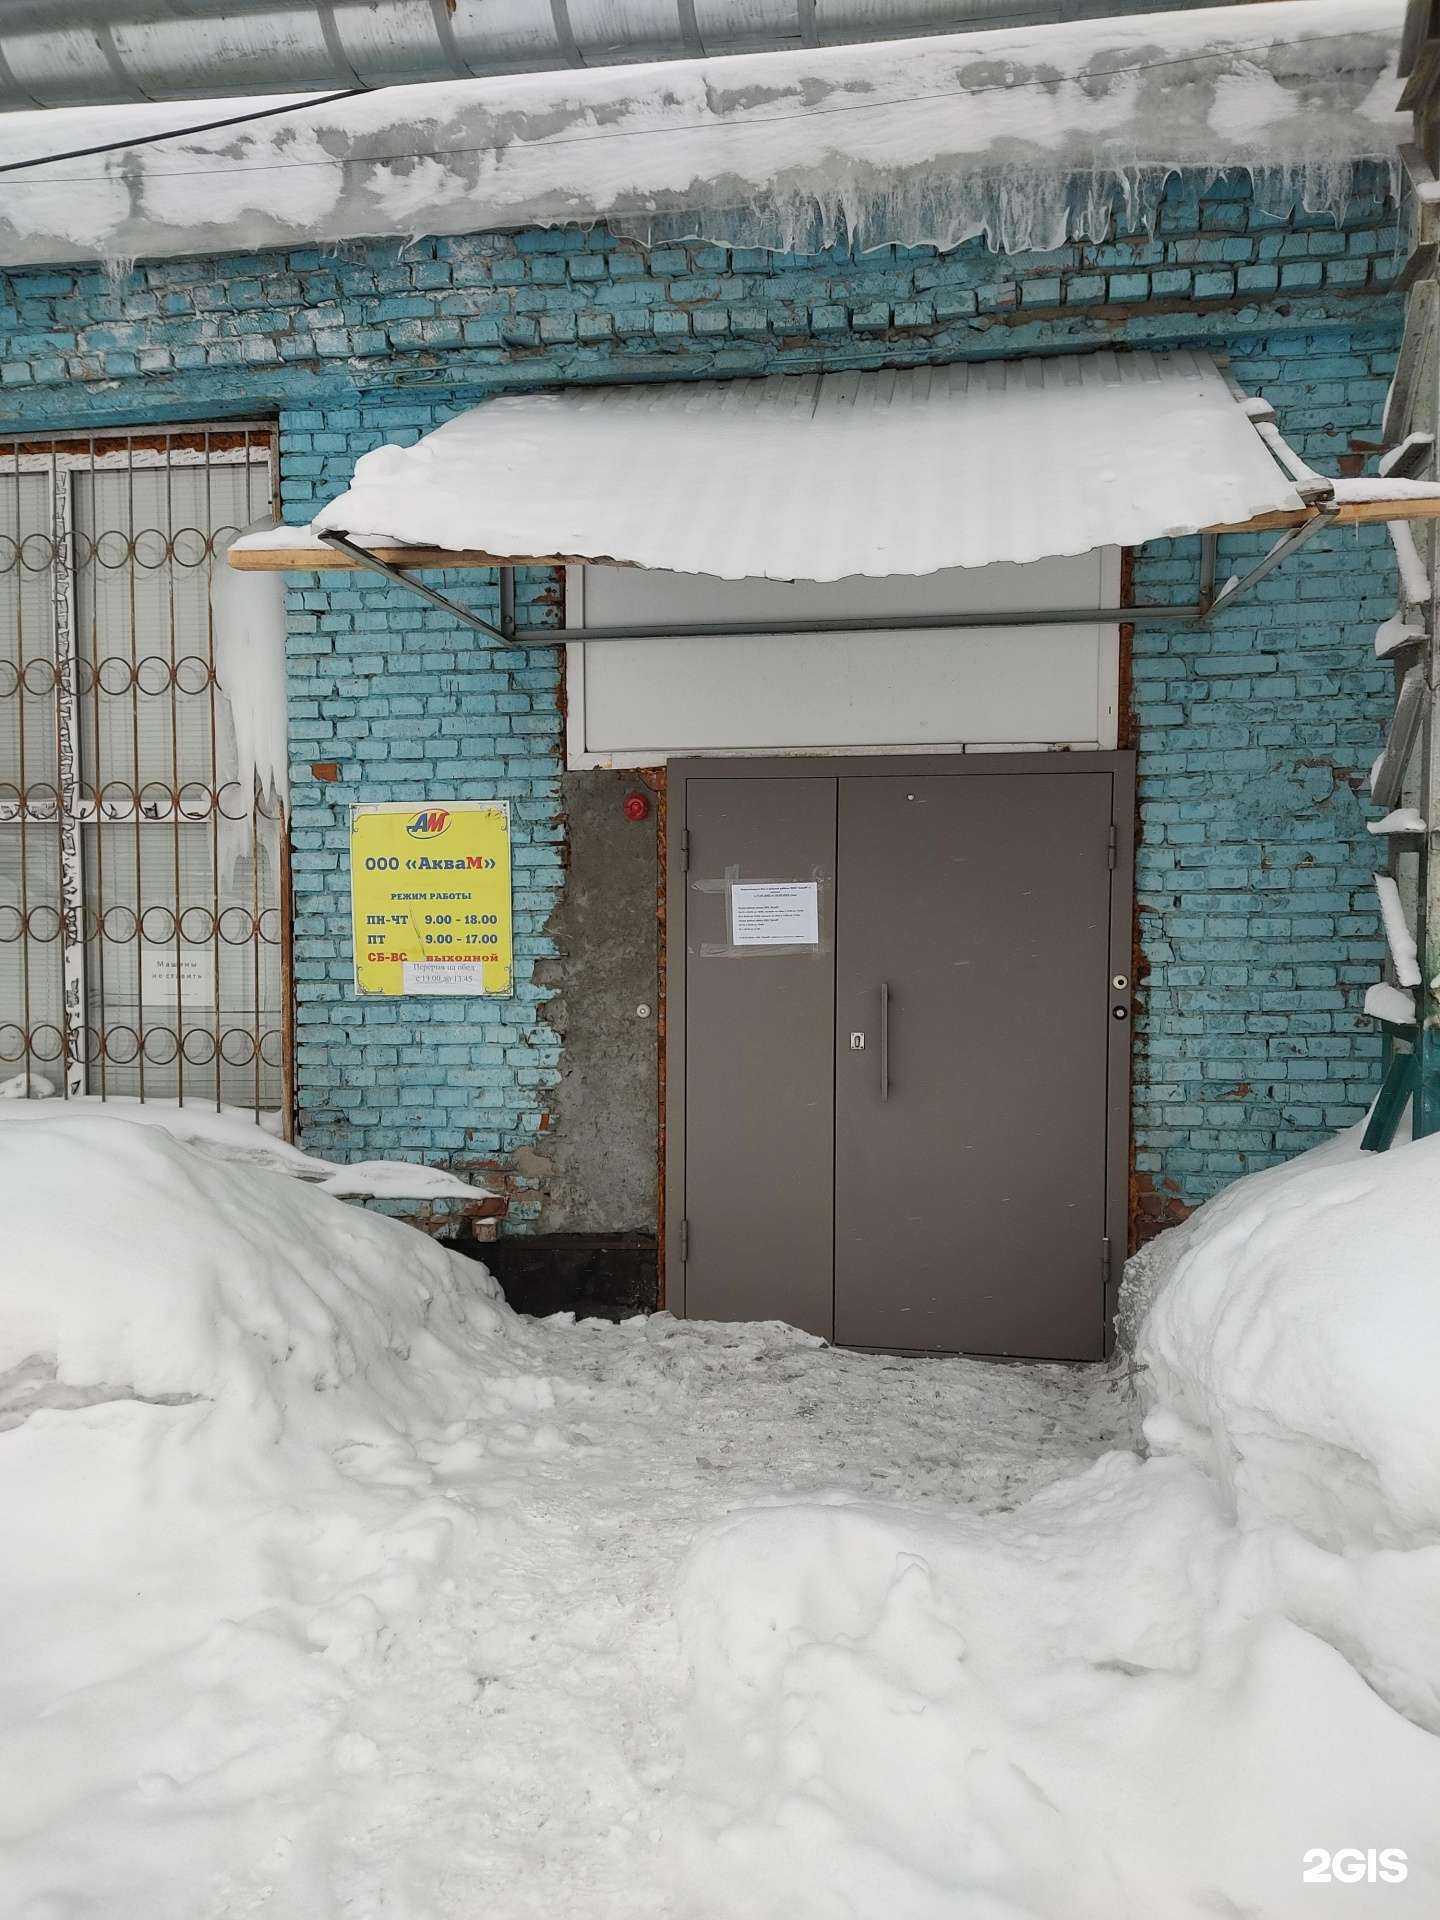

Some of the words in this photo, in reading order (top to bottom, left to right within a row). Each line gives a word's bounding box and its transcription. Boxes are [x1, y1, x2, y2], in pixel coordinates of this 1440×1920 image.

[365, 857, 400, 871] ООО
[405, 856, 496, 870] «АкваМ»
[430, 892, 472, 900] РАБОТЫ
[366, 915, 408, 925] ПН-ЧТ
[424, 915, 452, 925] 9.00
[464, 915, 498, 925] 18.00
[367, 934, 386, 945] ПТ
[425, 934, 453, 944] 9.00
[465, 934, 498, 944] 17.00
[367, 952, 408, 962] СБ-ВС
[425, 953, 499, 962] выходной
